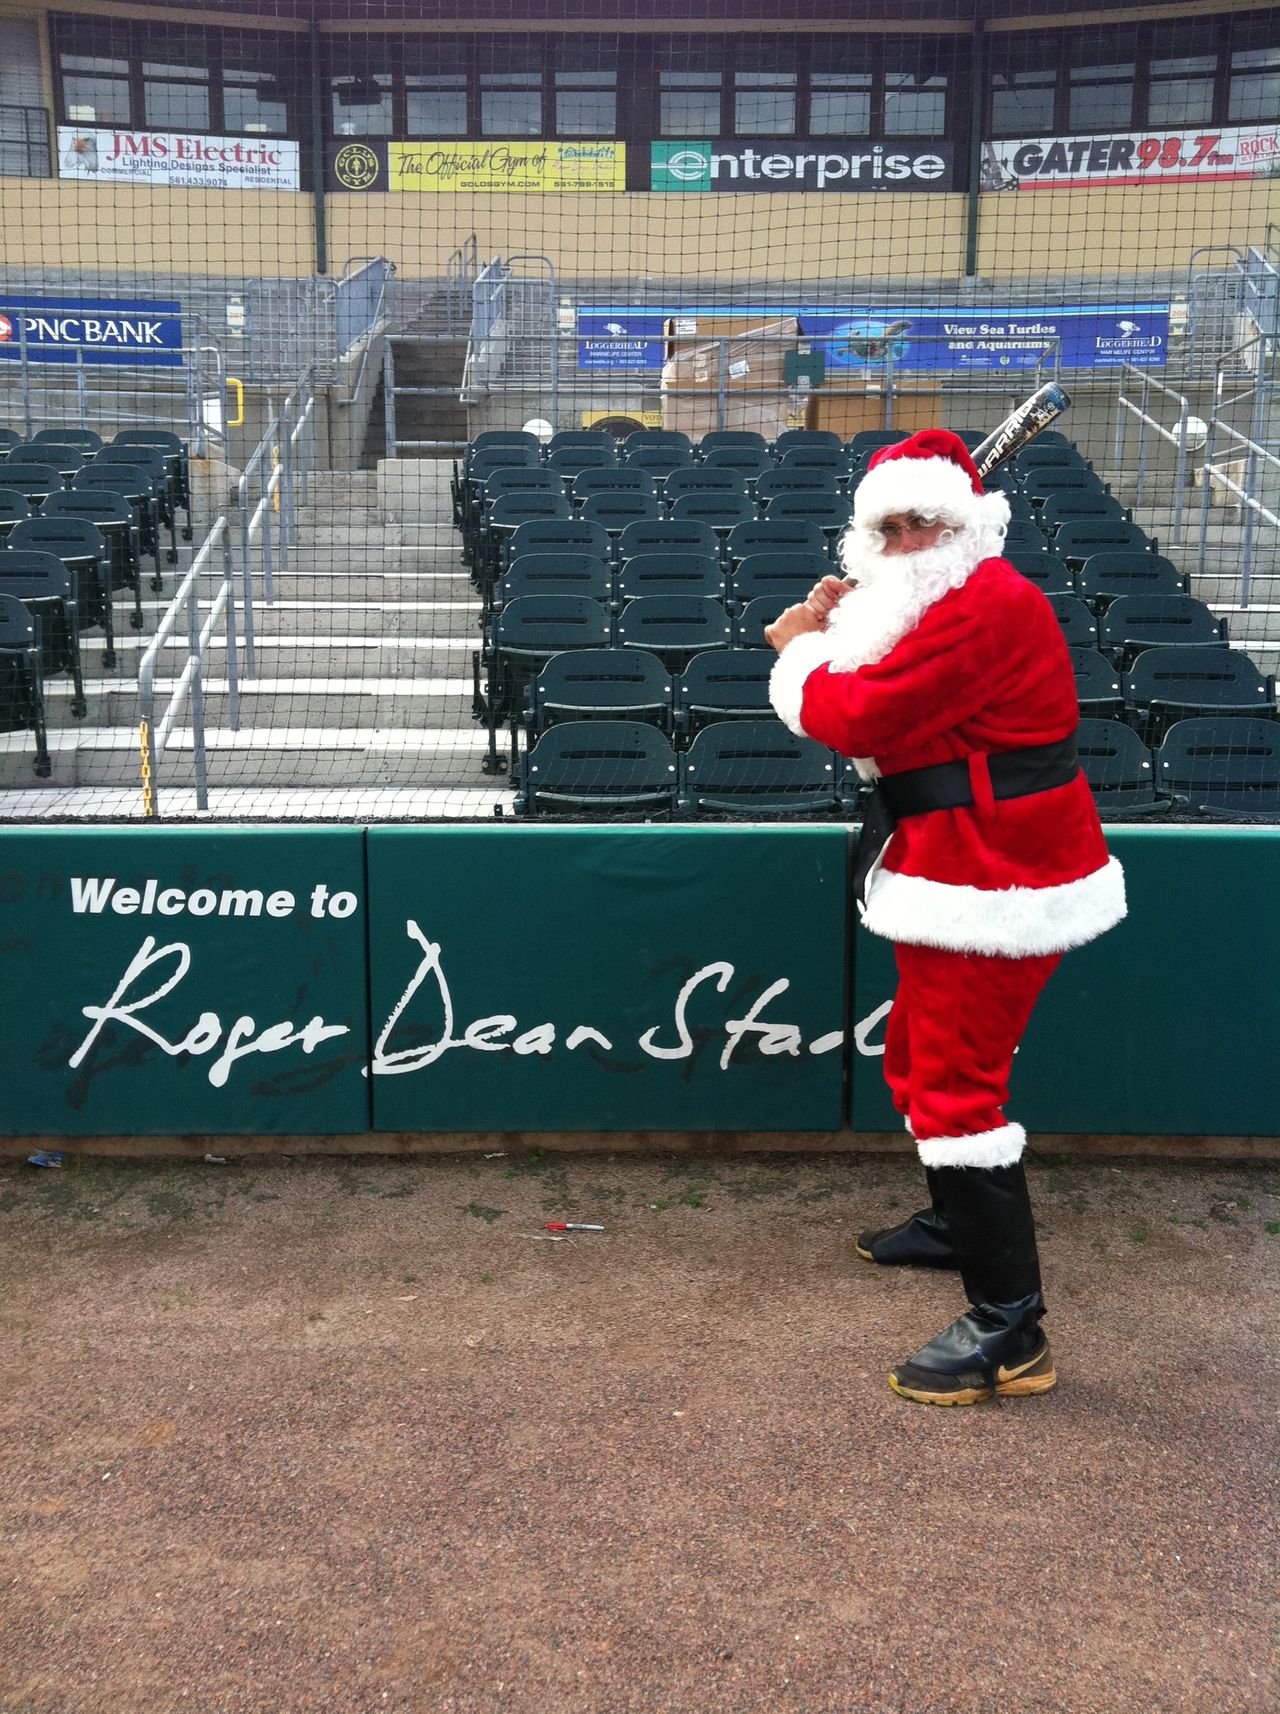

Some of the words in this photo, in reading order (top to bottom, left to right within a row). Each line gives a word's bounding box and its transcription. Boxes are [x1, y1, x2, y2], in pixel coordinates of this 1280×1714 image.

[106, 134, 168, 161] JMS
[175, 138, 282, 165] Electric
[122, 157, 167, 170] Lighting
[171, 160, 215, 173] Designs
[218, 162, 271, 175] Specialist
[398, 153, 422, 176] The
[426, 149, 489, 180] Official
[490, 147, 528, 176] Gym
[532, 147, 548, 175] of
[1013, 139, 1135, 176] GATER
[1136, 135, 1222, 169] 98.7
[668, 145, 946, 188] enterprise
[944, 323, 976, 335] View
[980, 323, 1005, 335] Sea
[1008, 323, 1056, 335] Turtles
[948, 340, 974, 350] and
[70, 877, 296, 917] Welcome
[310, 884, 358, 918] to
[68, 935, 350, 1088] Roger
[361, 919, 613, 1079] Dean
[638, 961, 893, 1070] Stad
